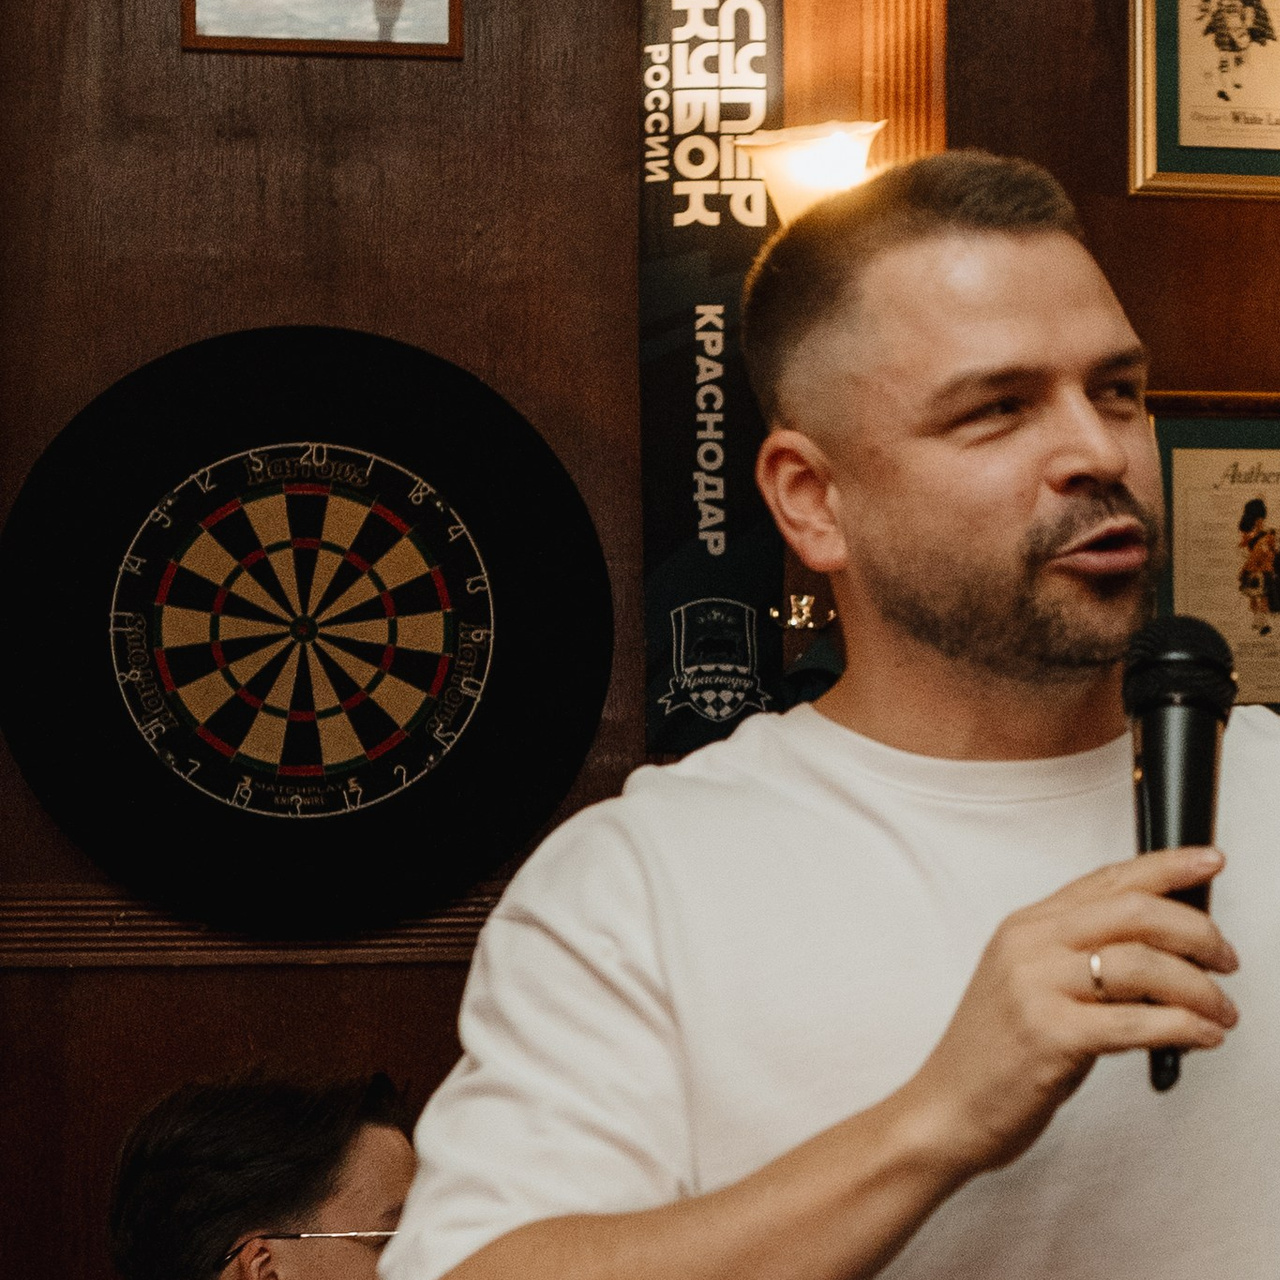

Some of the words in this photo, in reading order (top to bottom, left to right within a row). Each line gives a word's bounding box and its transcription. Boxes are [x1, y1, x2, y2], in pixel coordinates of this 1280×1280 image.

[644, 42, 671, 184] РОССИИ
[693, 303, 725, 558] КРАСНОДАР
[248, 450, 264, 473] 5
[300, 441, 328, 466] 20
[193, 469, 218, 493] 12
[407, 477, 432, 505] 18
[183, 757, 201, 780] 7
[253, 781, 345, 795] MATCHPLAY
